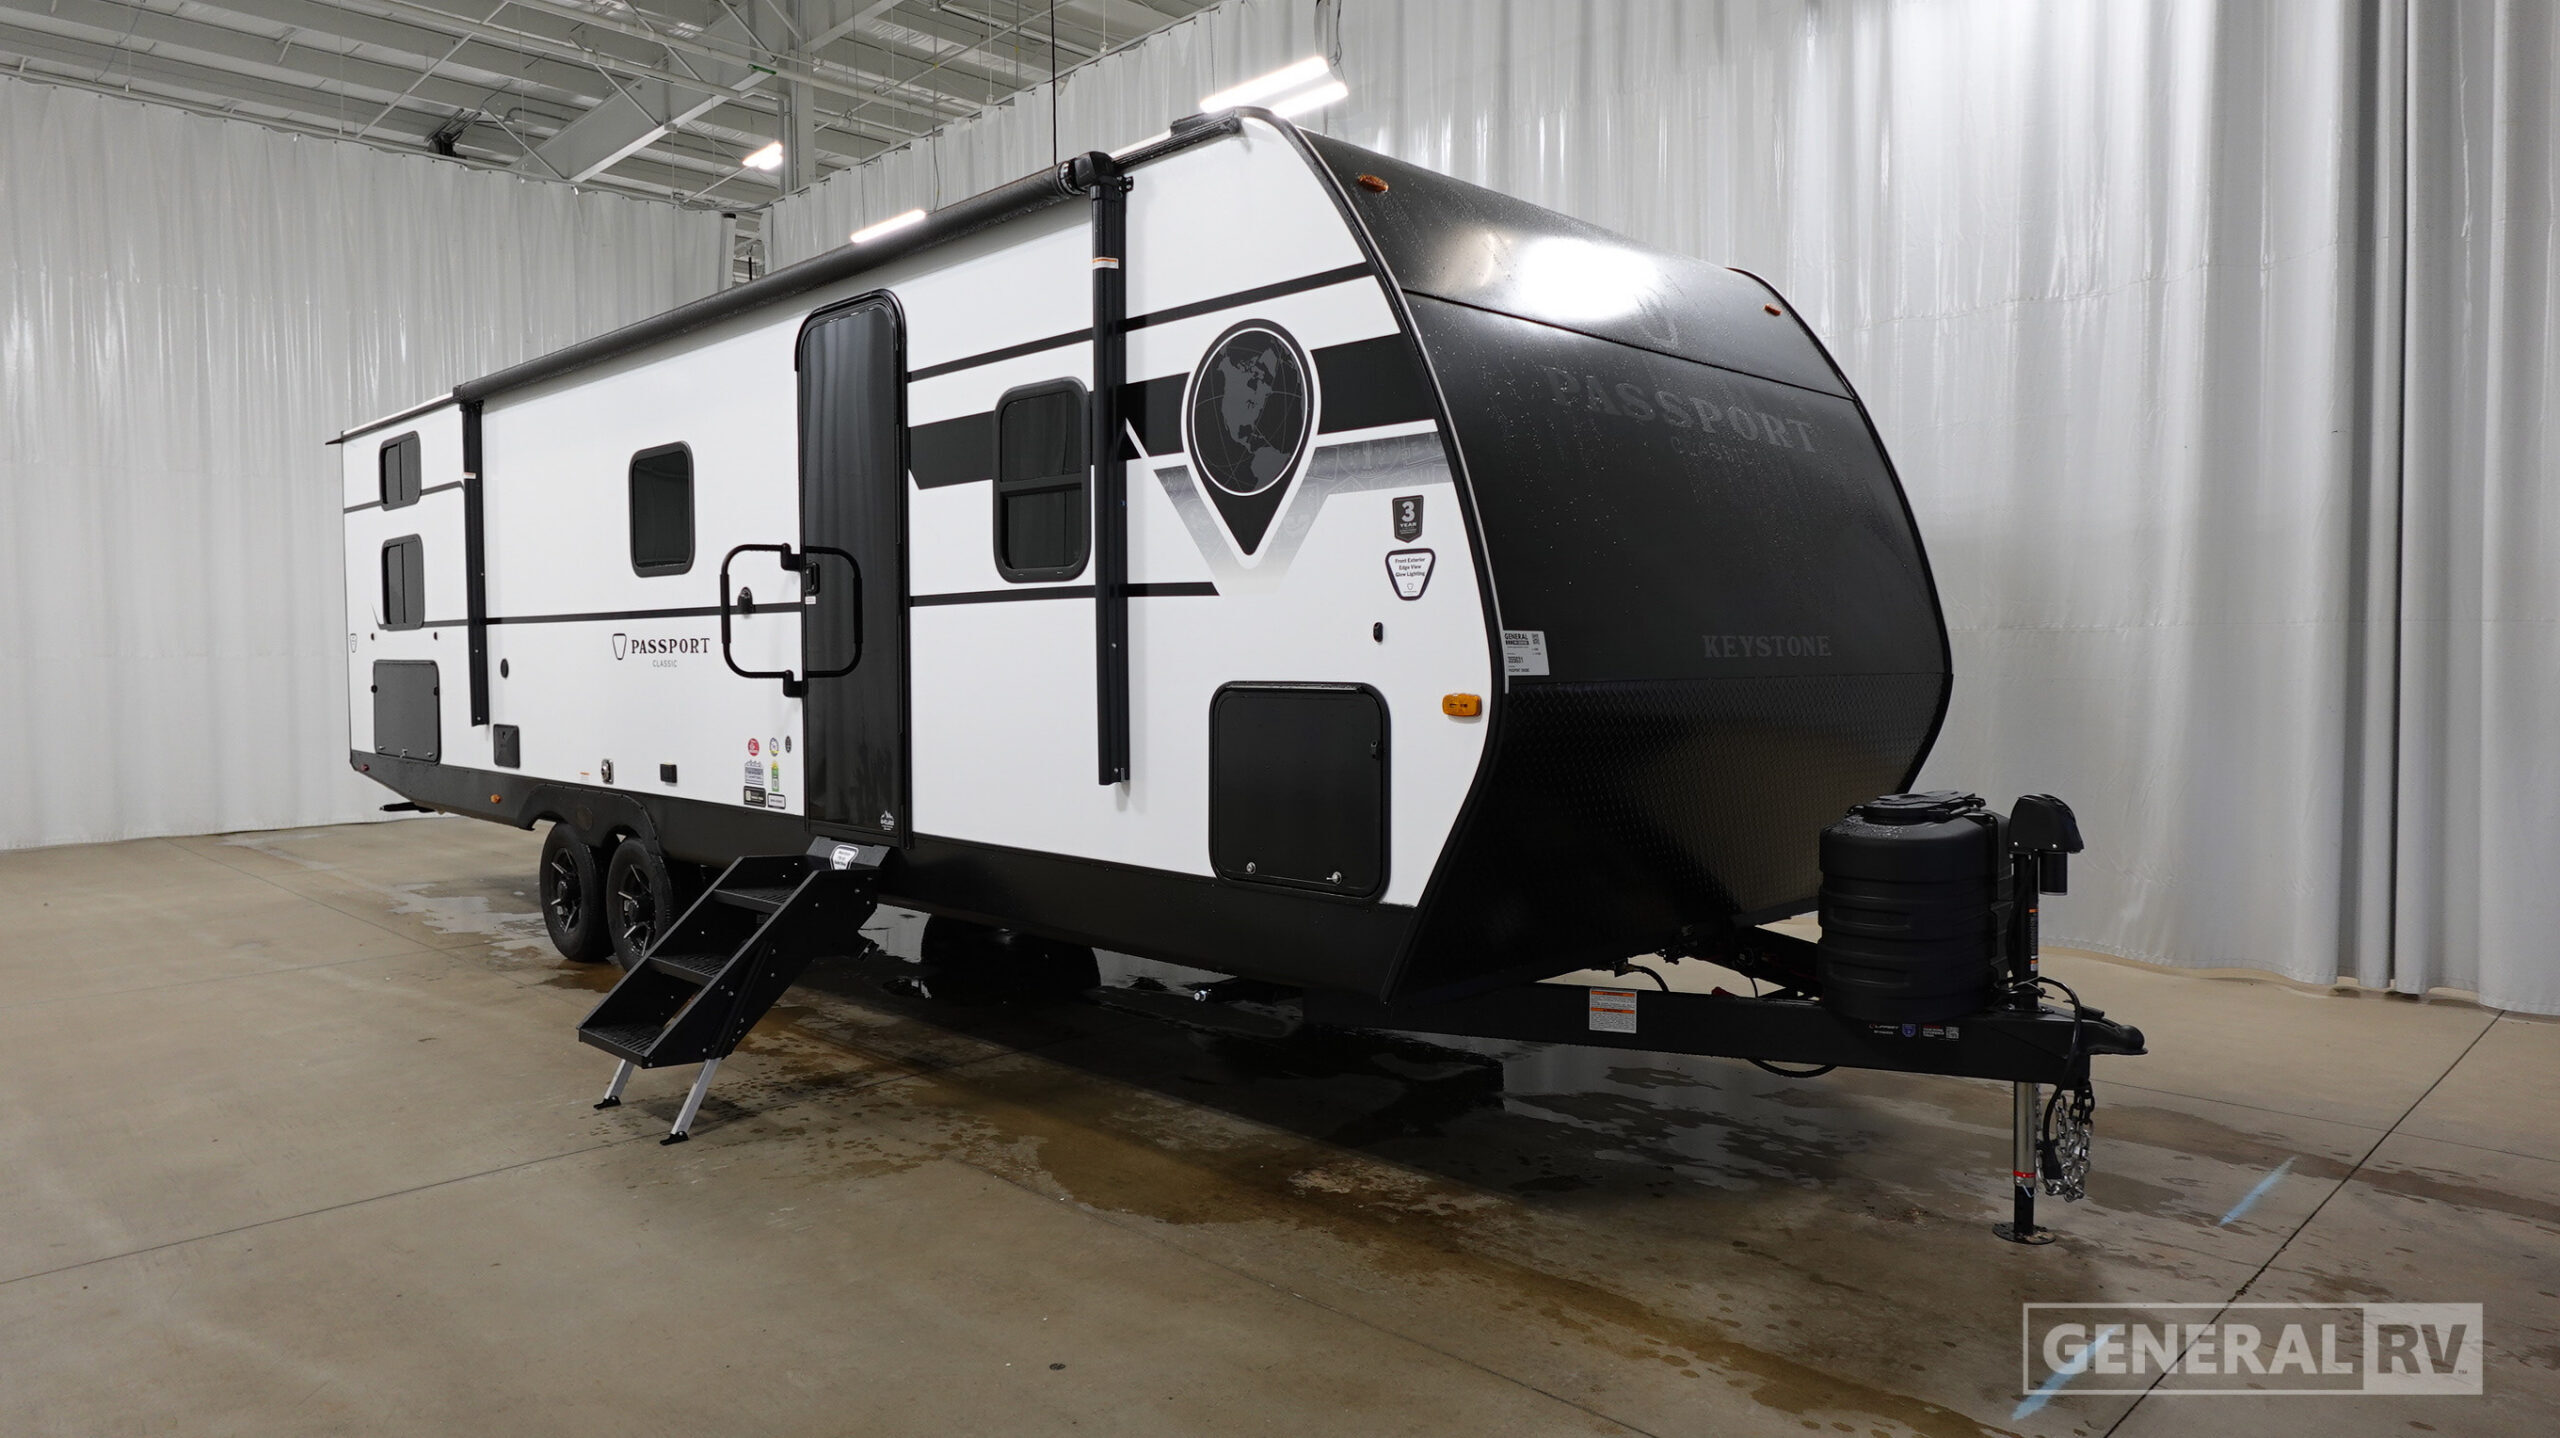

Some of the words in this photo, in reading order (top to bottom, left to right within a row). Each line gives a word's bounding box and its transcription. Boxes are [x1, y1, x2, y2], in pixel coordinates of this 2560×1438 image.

[1540, 364, 1816, 453] PASSPORT
[1401, 500, 1416, 522] 3
[631, 638, 710, 653] PASSPORT
[1702, 634, 1832, 658] KEYSTONE
[652, 659, 678, 668] CLASSIC
